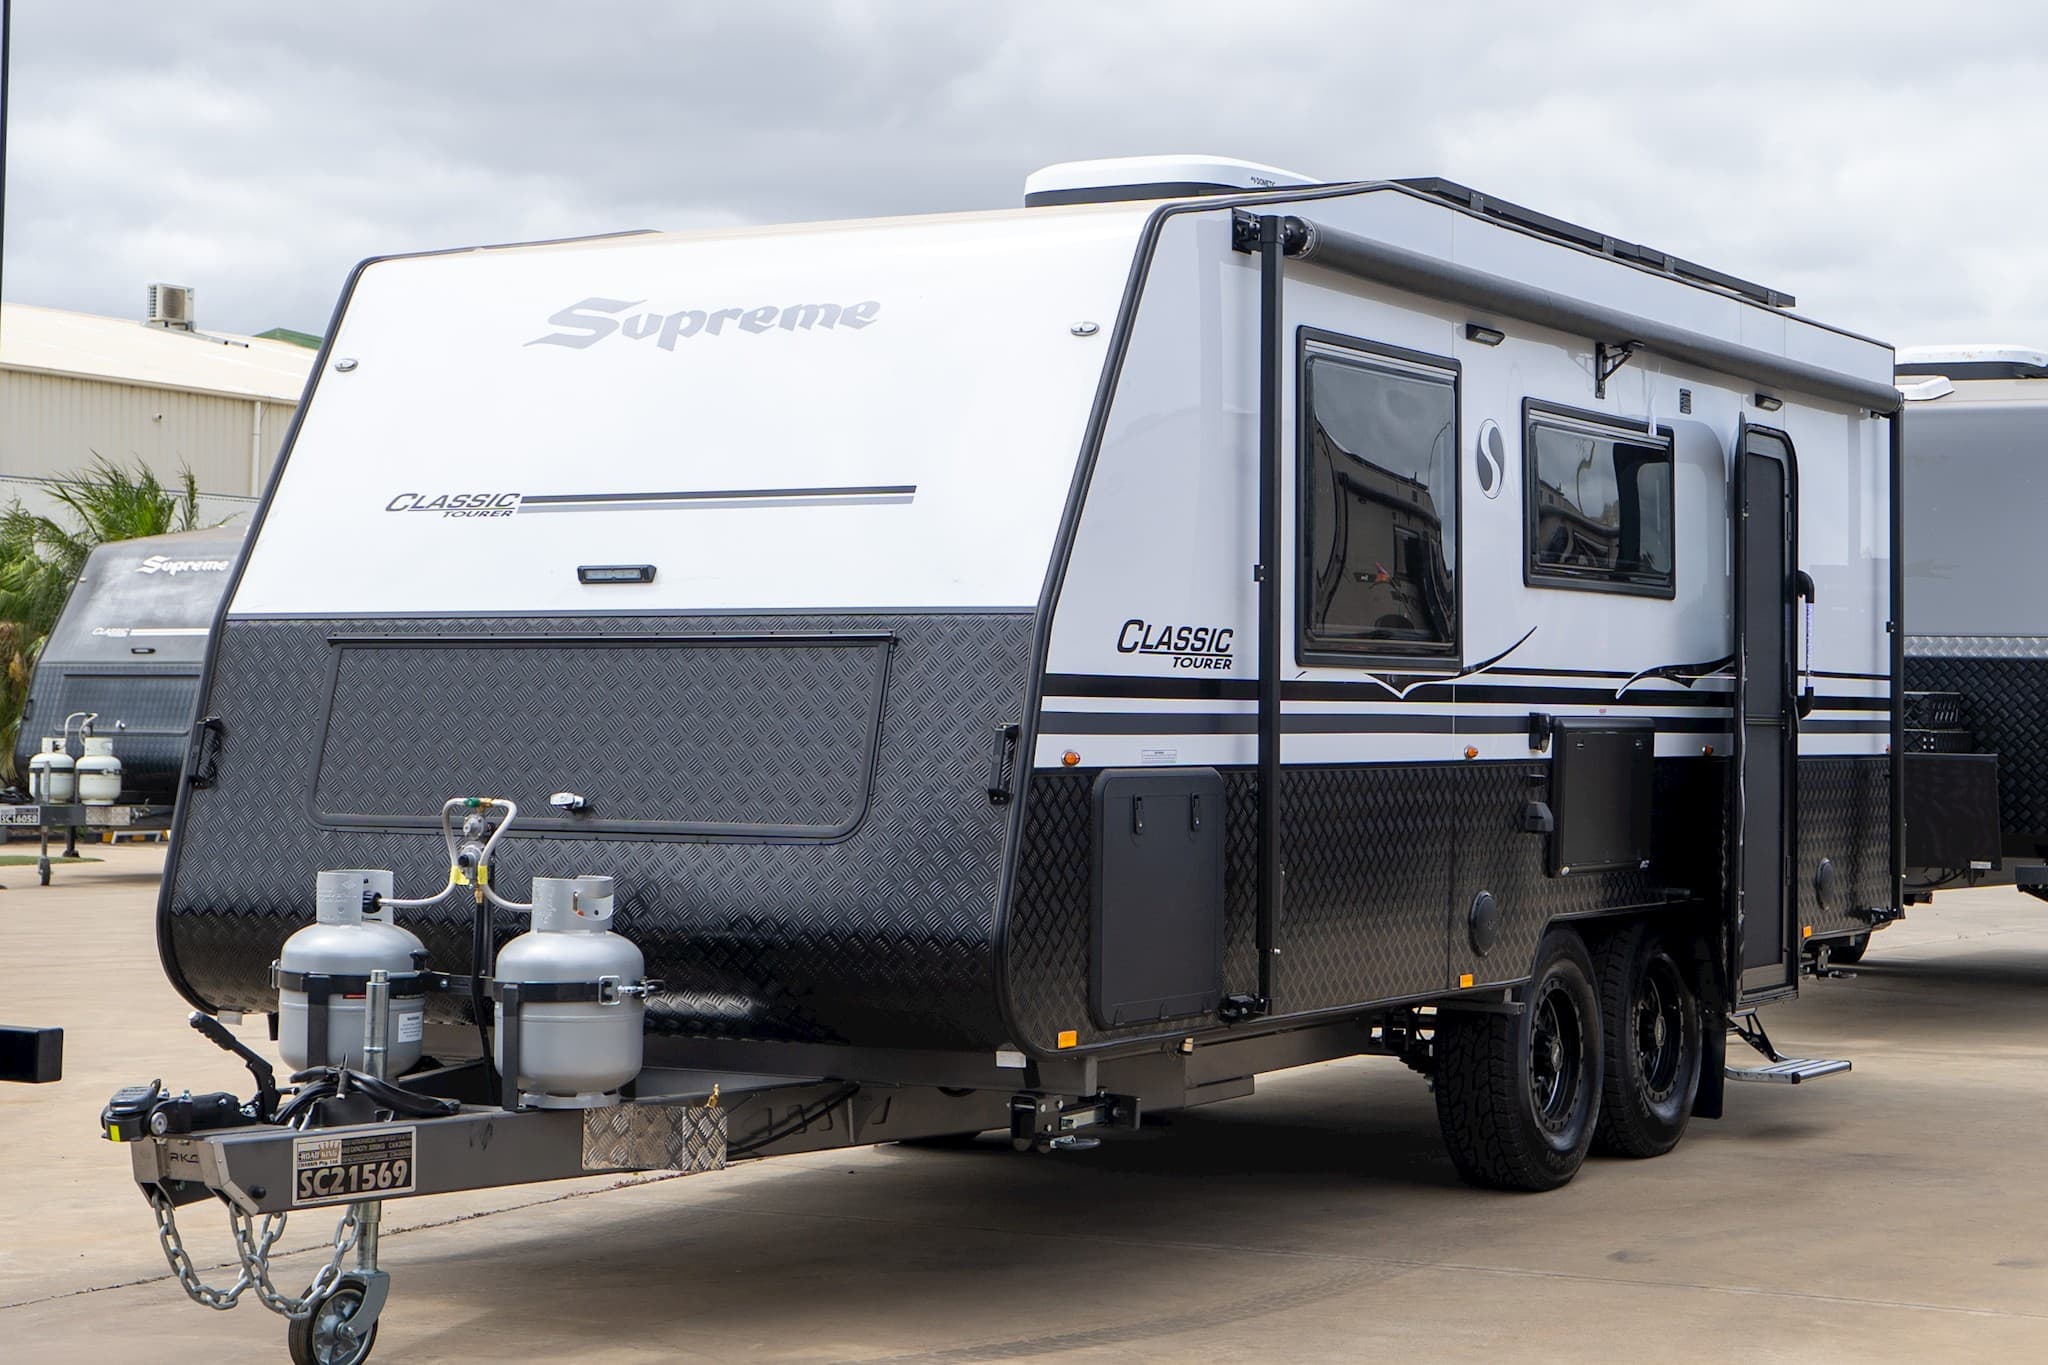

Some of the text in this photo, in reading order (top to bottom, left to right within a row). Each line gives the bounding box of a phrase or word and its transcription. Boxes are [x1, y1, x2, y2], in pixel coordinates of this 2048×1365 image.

[522, 297, 881, 352] Supreme
[385, 493, 520, 512] CLASSIC
[442, 510, 513, 518] TOURER
[135, 555, 229, 576] Supreme
[1117, 619, 1234, 653] CLASSIC
[1173, 656, 1232, 670] TOURER
[300, 1159, 408, 1198] SC21569
